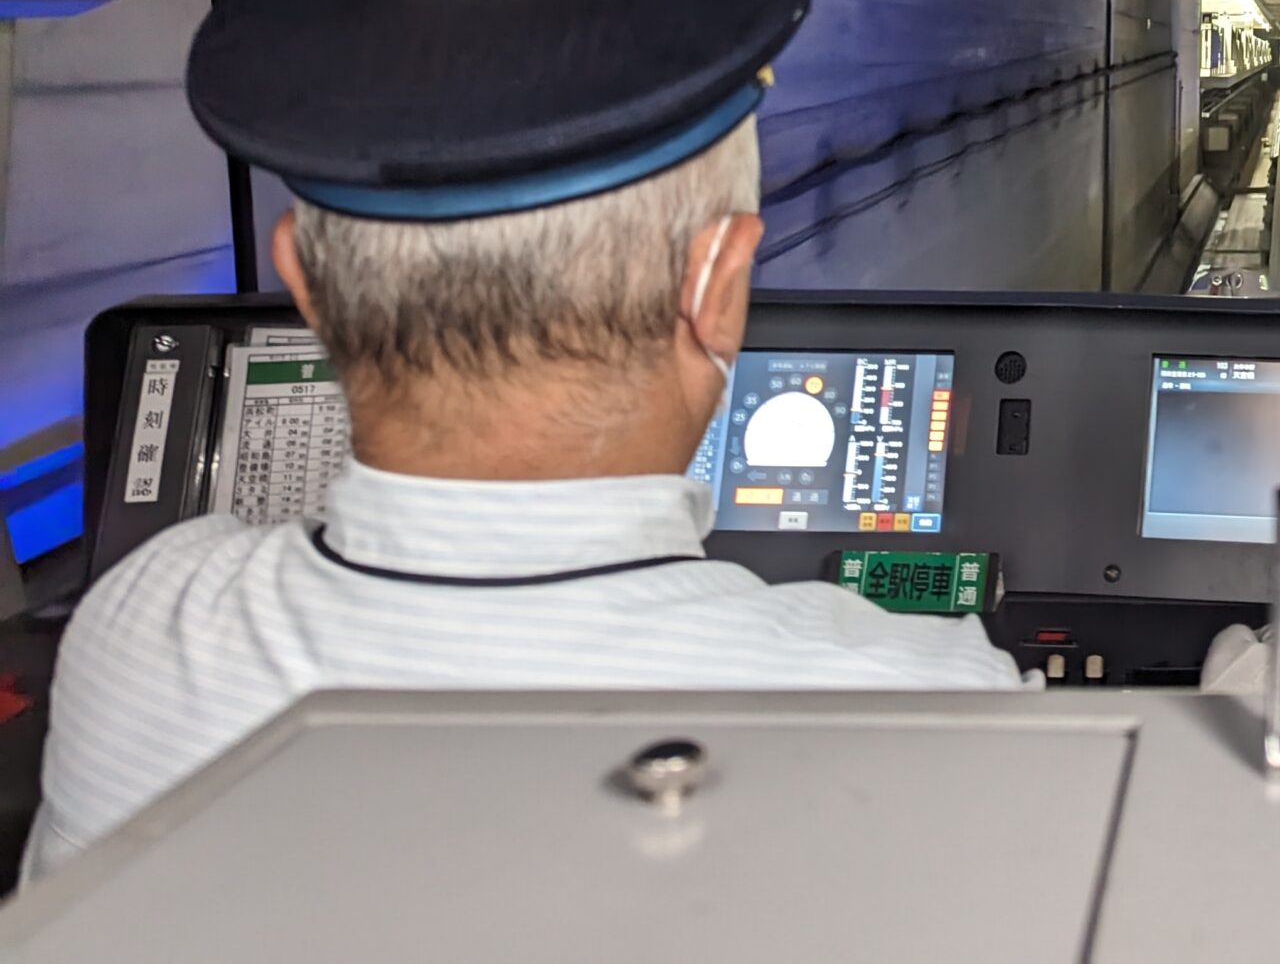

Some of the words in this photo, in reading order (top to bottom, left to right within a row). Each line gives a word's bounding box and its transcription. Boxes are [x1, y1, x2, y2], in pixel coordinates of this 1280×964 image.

[735, 412, 746, 422] 25
[863, 561, 953, 601] 全駅停車
[956, 562, 980, 606] 普通
